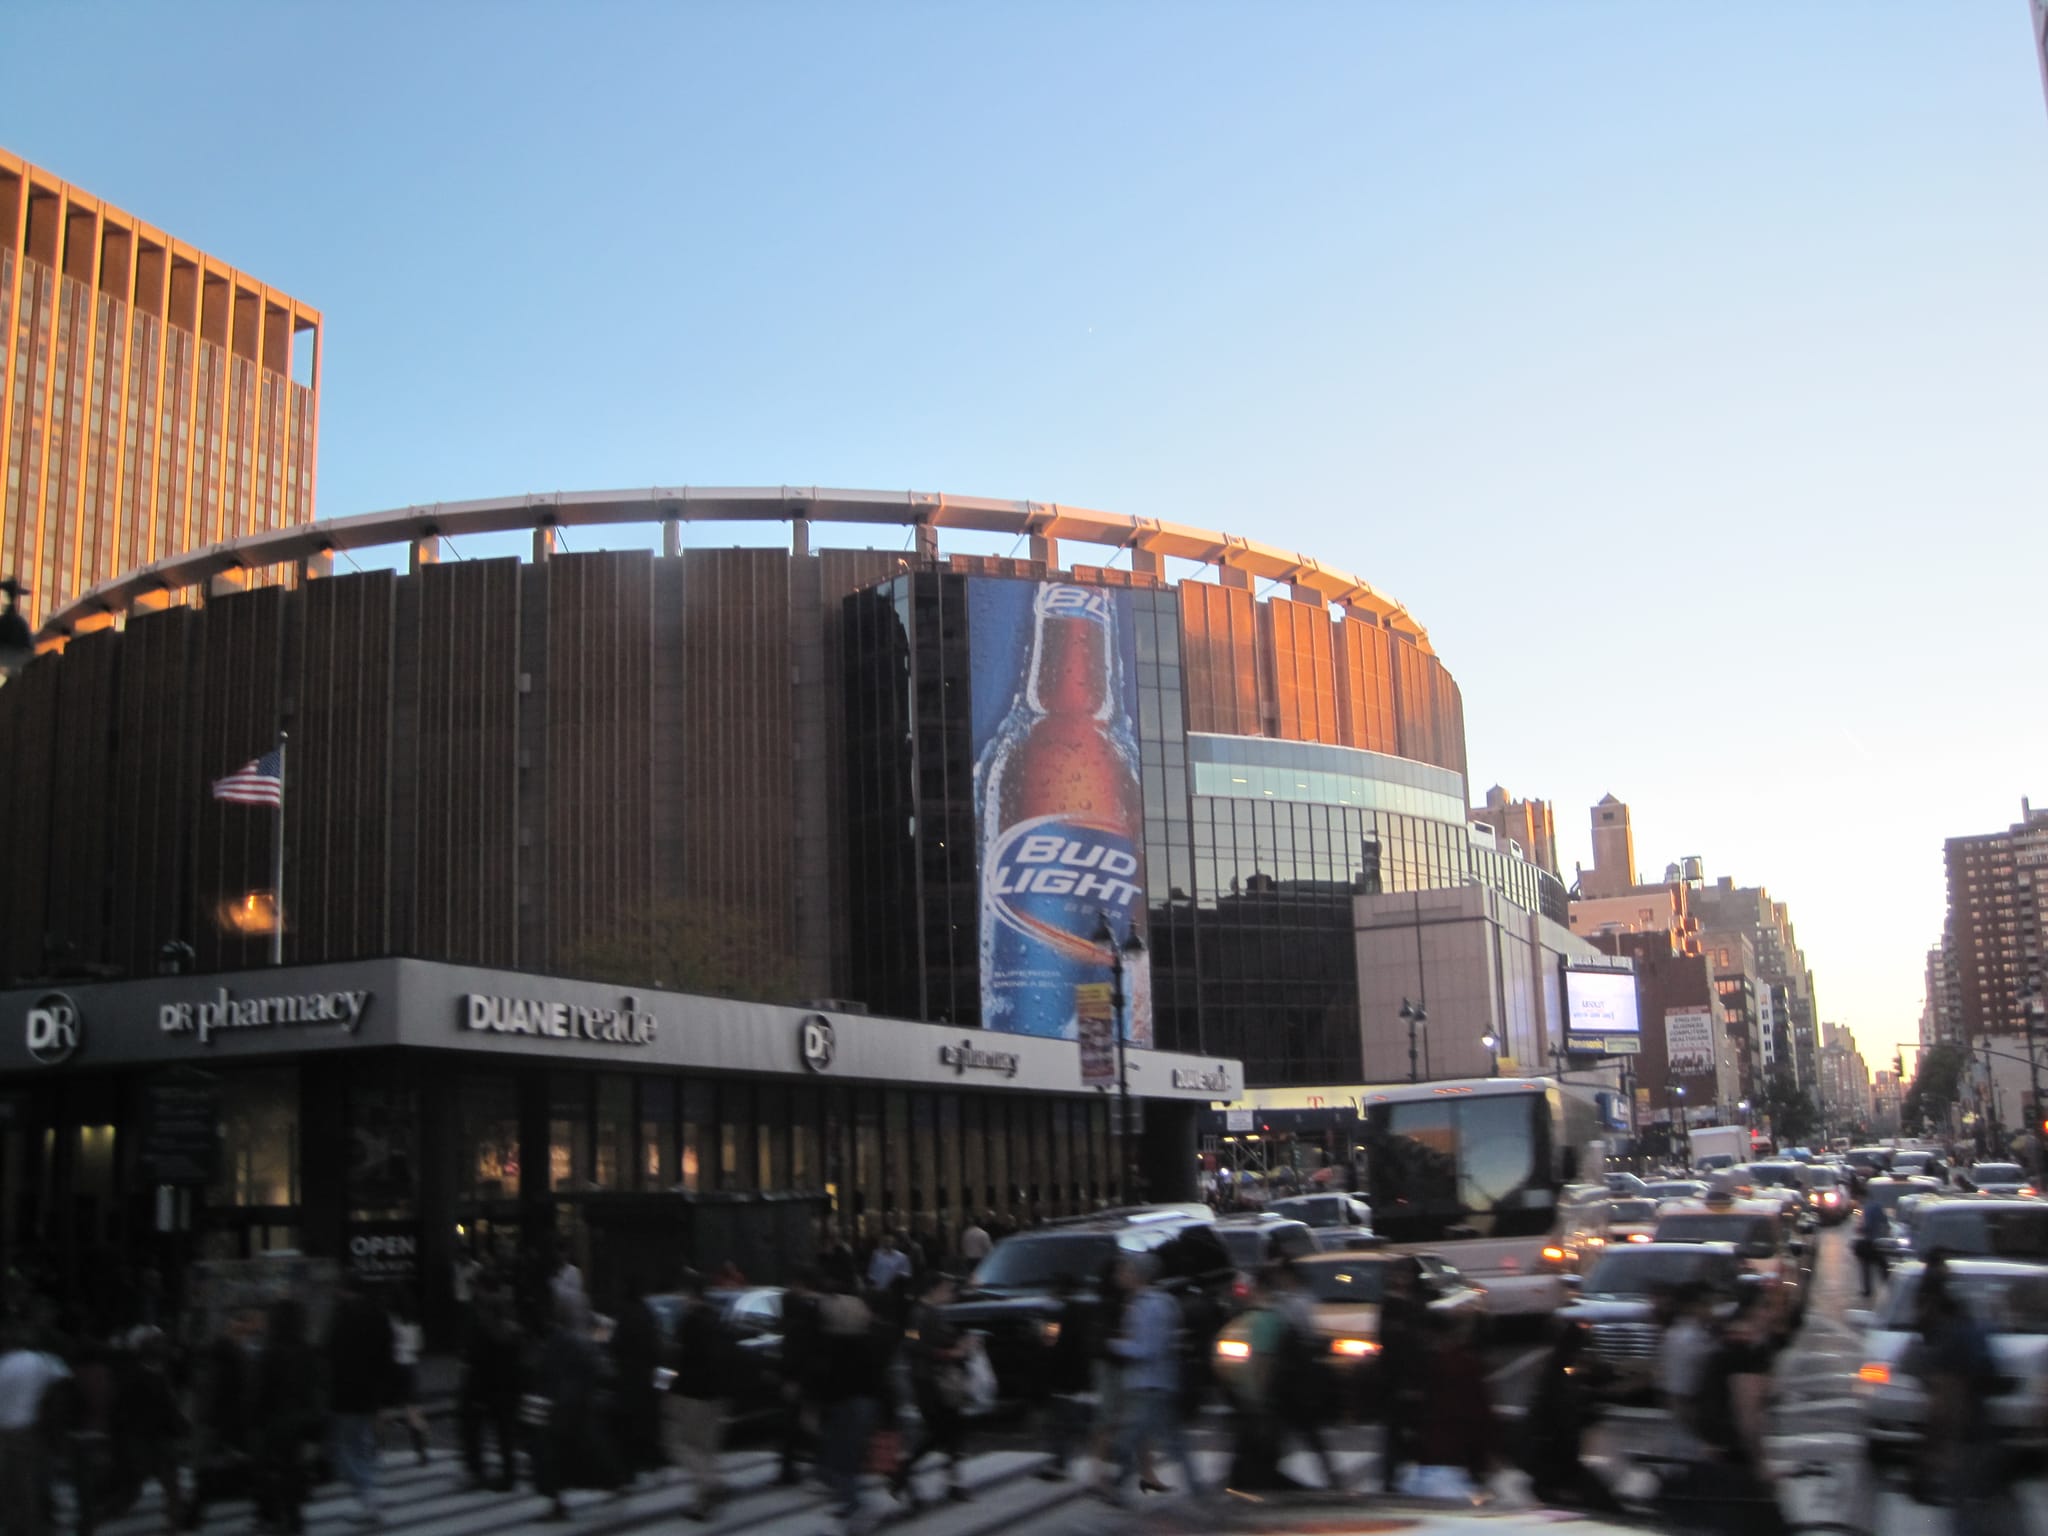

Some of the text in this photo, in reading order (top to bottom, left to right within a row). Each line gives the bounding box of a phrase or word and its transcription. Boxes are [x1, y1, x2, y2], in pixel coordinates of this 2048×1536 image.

[1015, 834, 1139, 877] BUD
[996, 865, 1142, 906] LIGHT
[26, 1005, 78, 1049] DR
[159, 987, 368, 1043] DR pharmacy
[350, 1235, 417, 1257] OPEN
